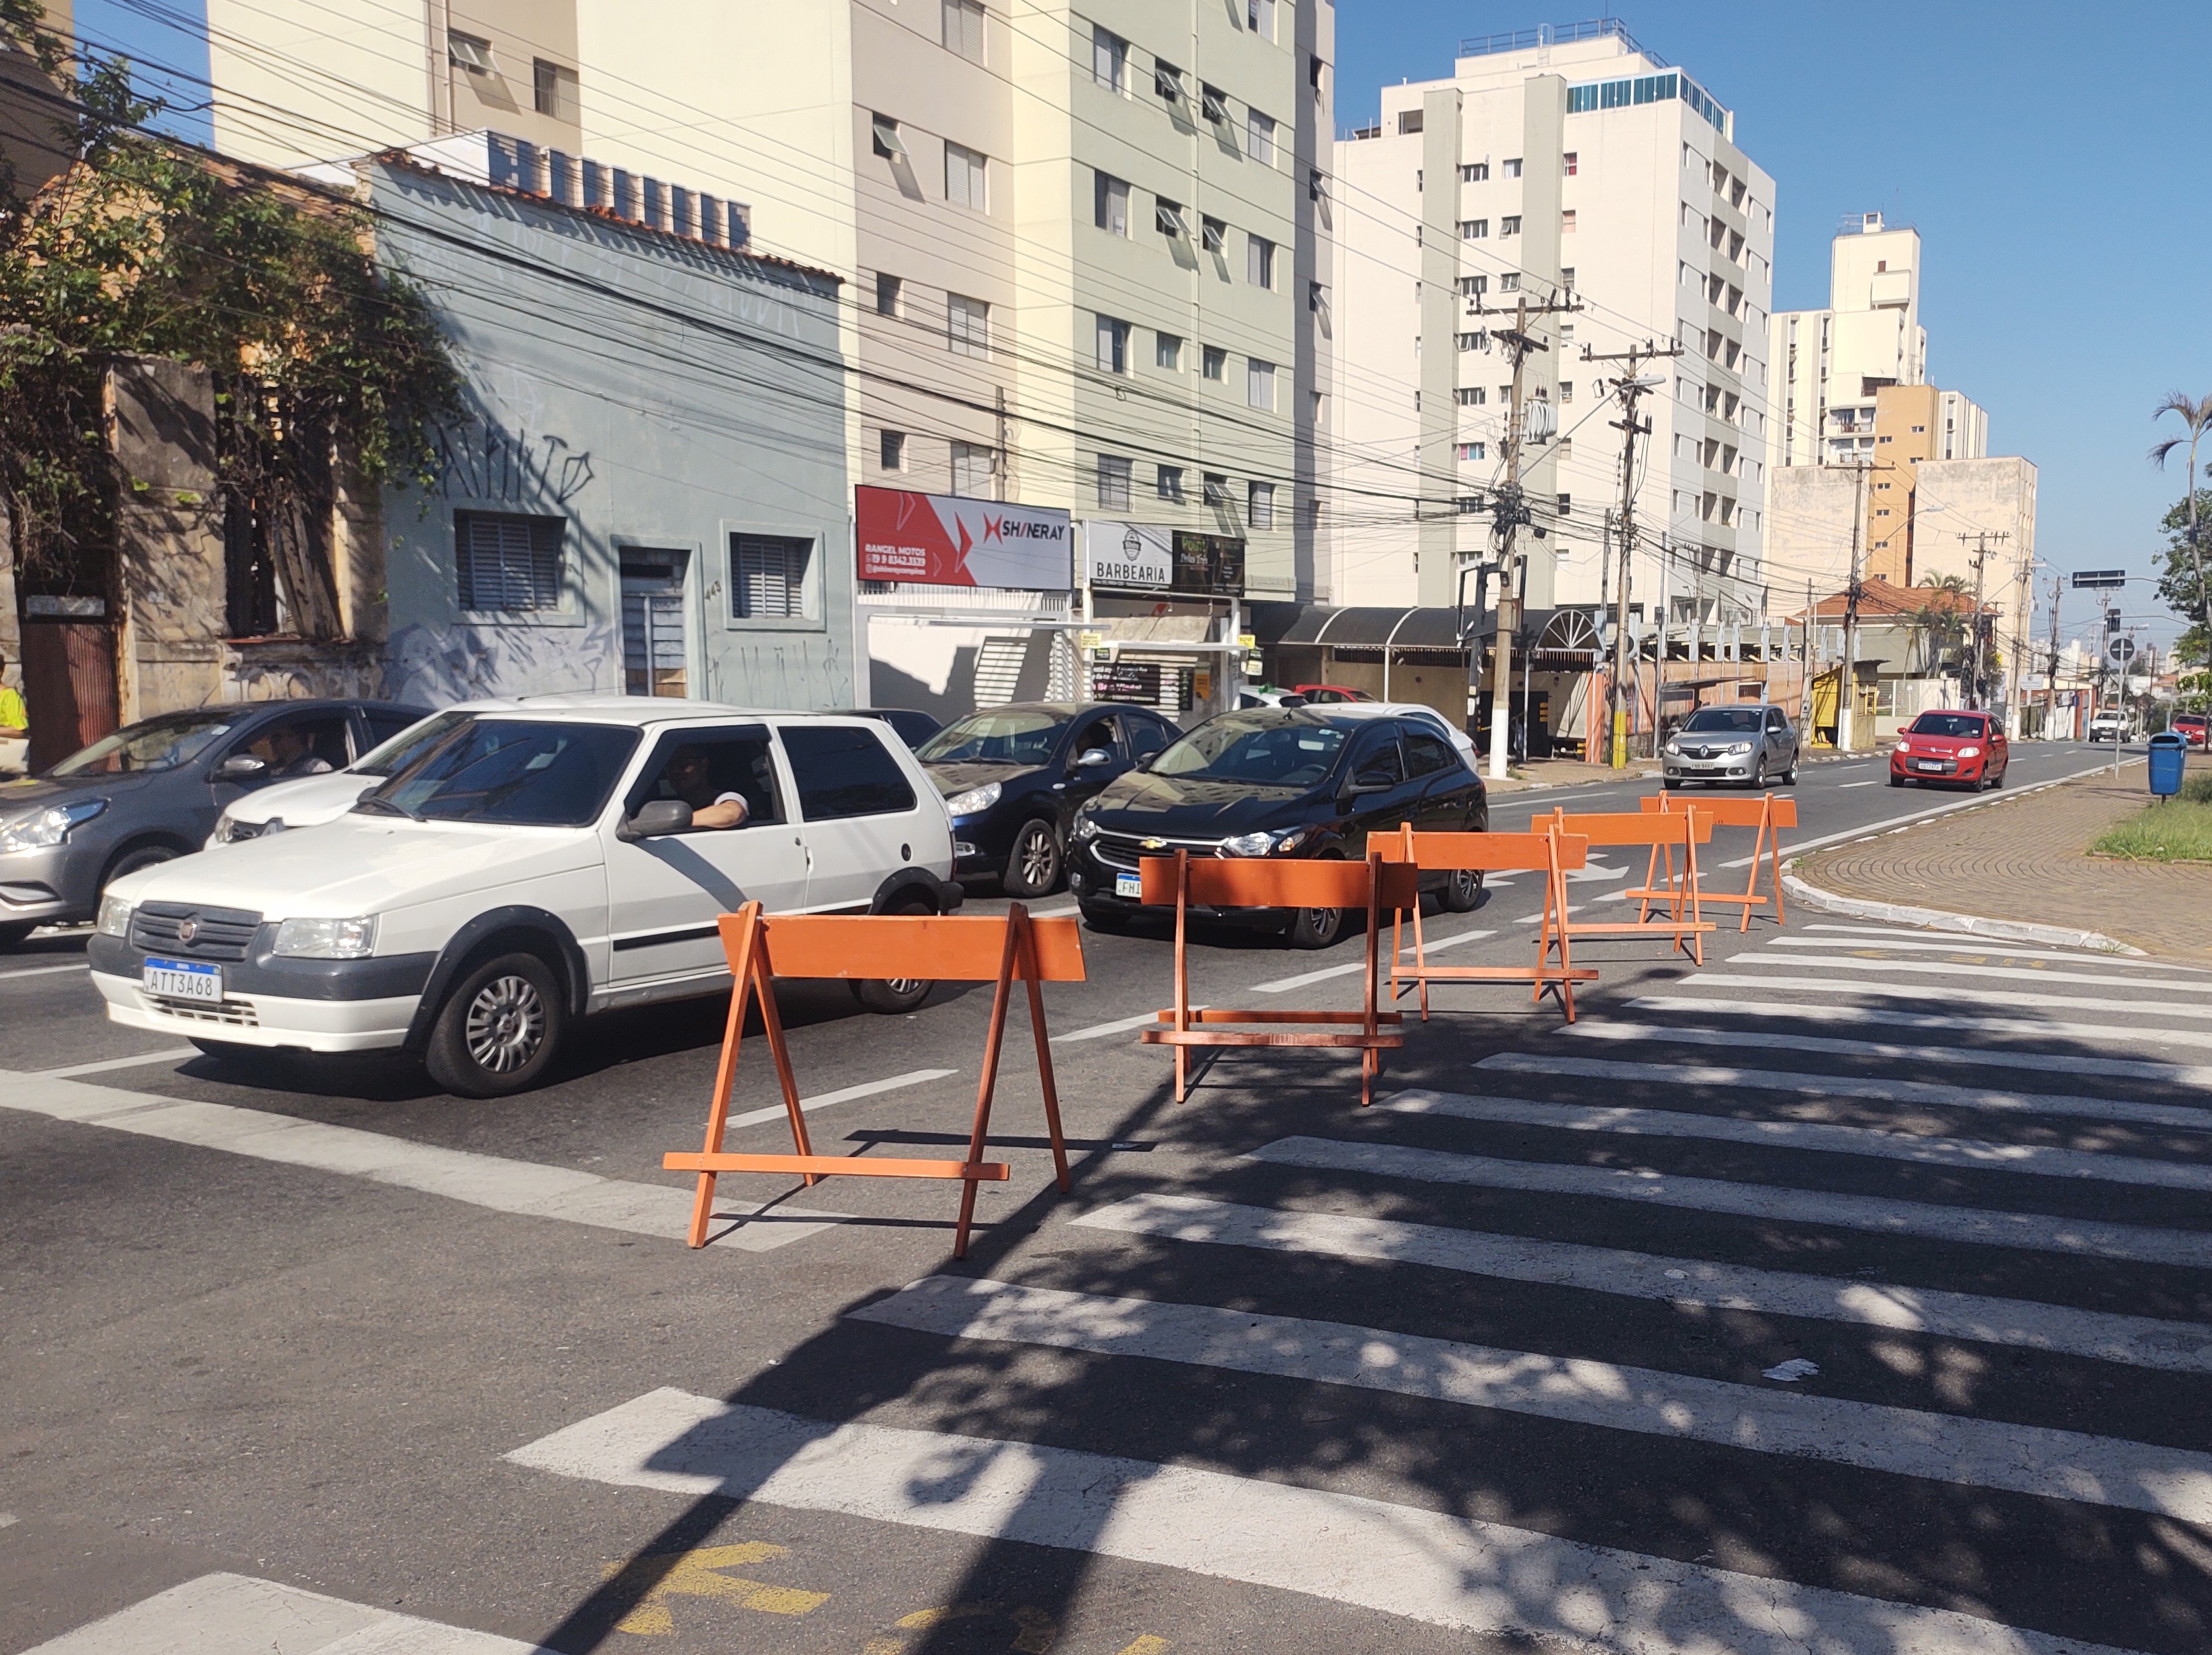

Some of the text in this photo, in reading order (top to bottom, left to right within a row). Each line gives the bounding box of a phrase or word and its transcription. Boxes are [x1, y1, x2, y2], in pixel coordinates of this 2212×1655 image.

[1003, 520, 1064, 541] SHINERAY
[898, 546, 926, 557] MOTOS
[1097, 562, 1165, 582] BARBEARIA
[151, 970, 212, 996] ATT3A68
